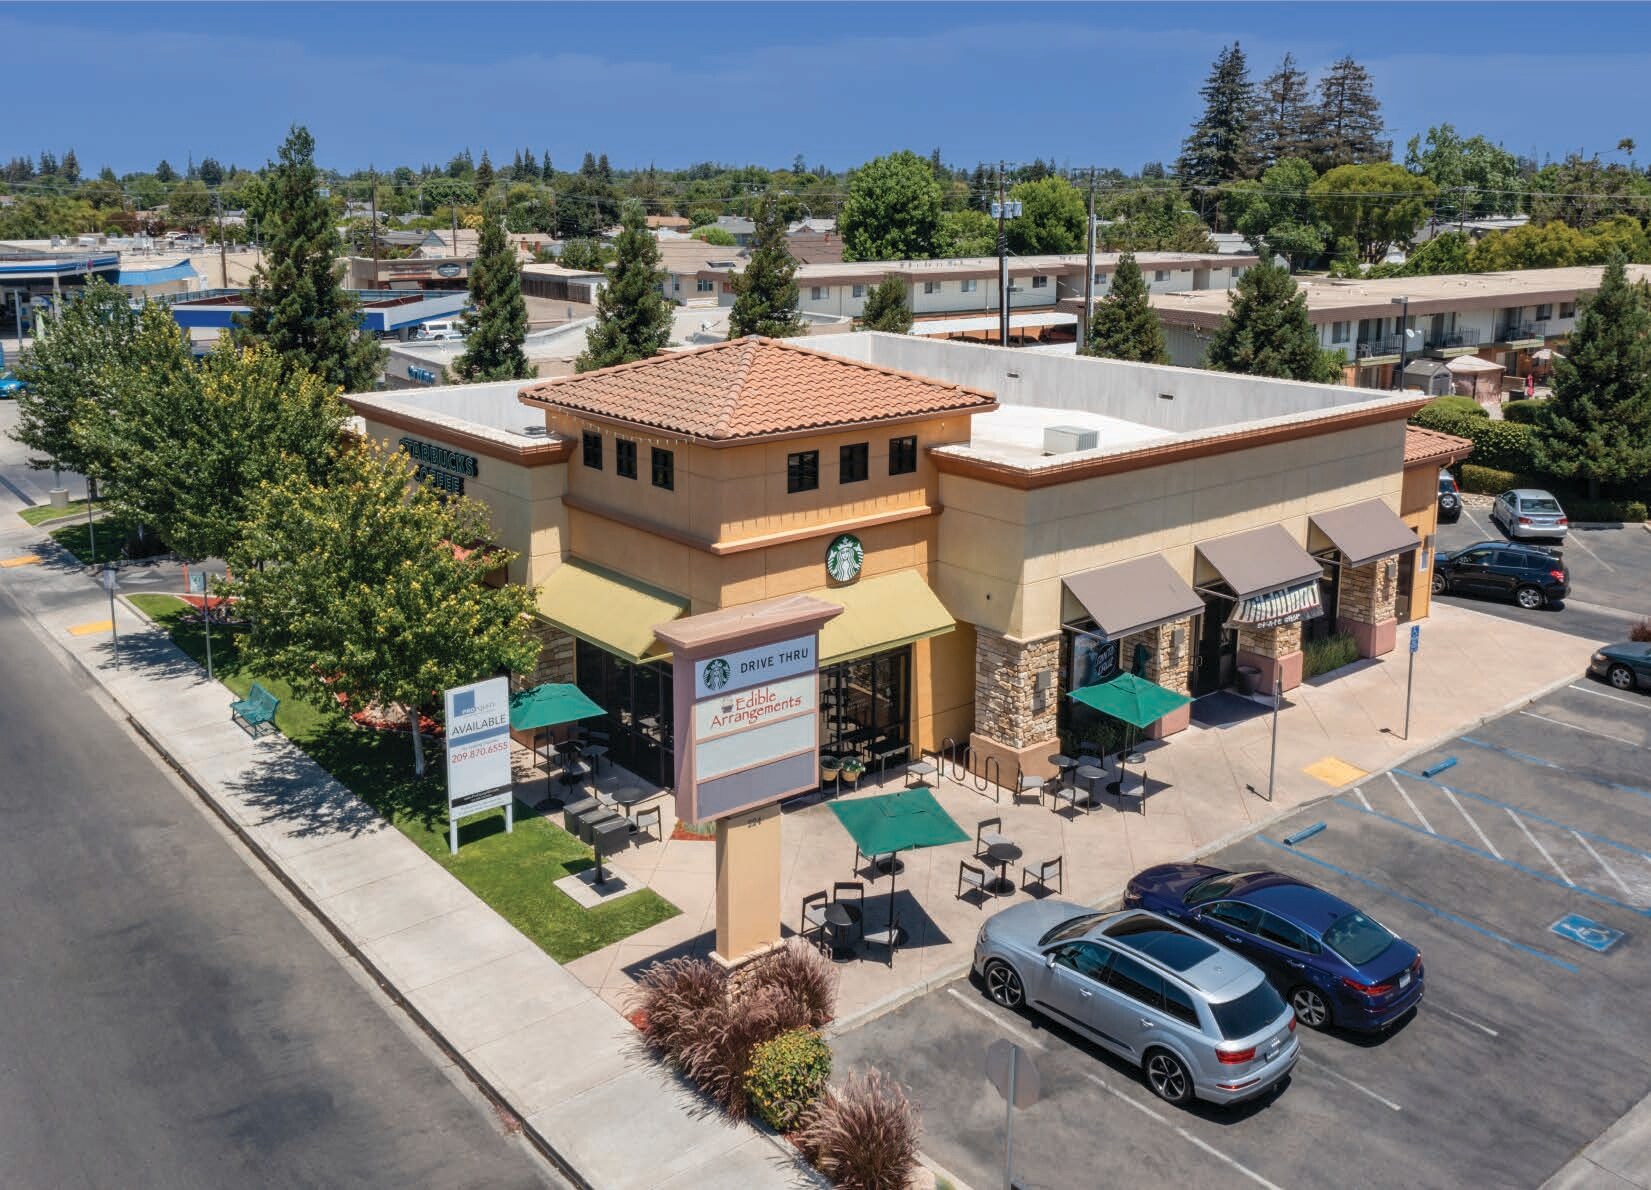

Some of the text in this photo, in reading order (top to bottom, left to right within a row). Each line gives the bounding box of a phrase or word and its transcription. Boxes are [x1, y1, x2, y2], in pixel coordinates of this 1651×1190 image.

[740, 648, 809, 674] DRIVE THRU
[735, 687, 776, 711] Edible
[452, 714, 506, 736] AVAILABLE
[710, 696, 802, 730] Arrangements
[451, 742, 508, 764] 209.870.6555
